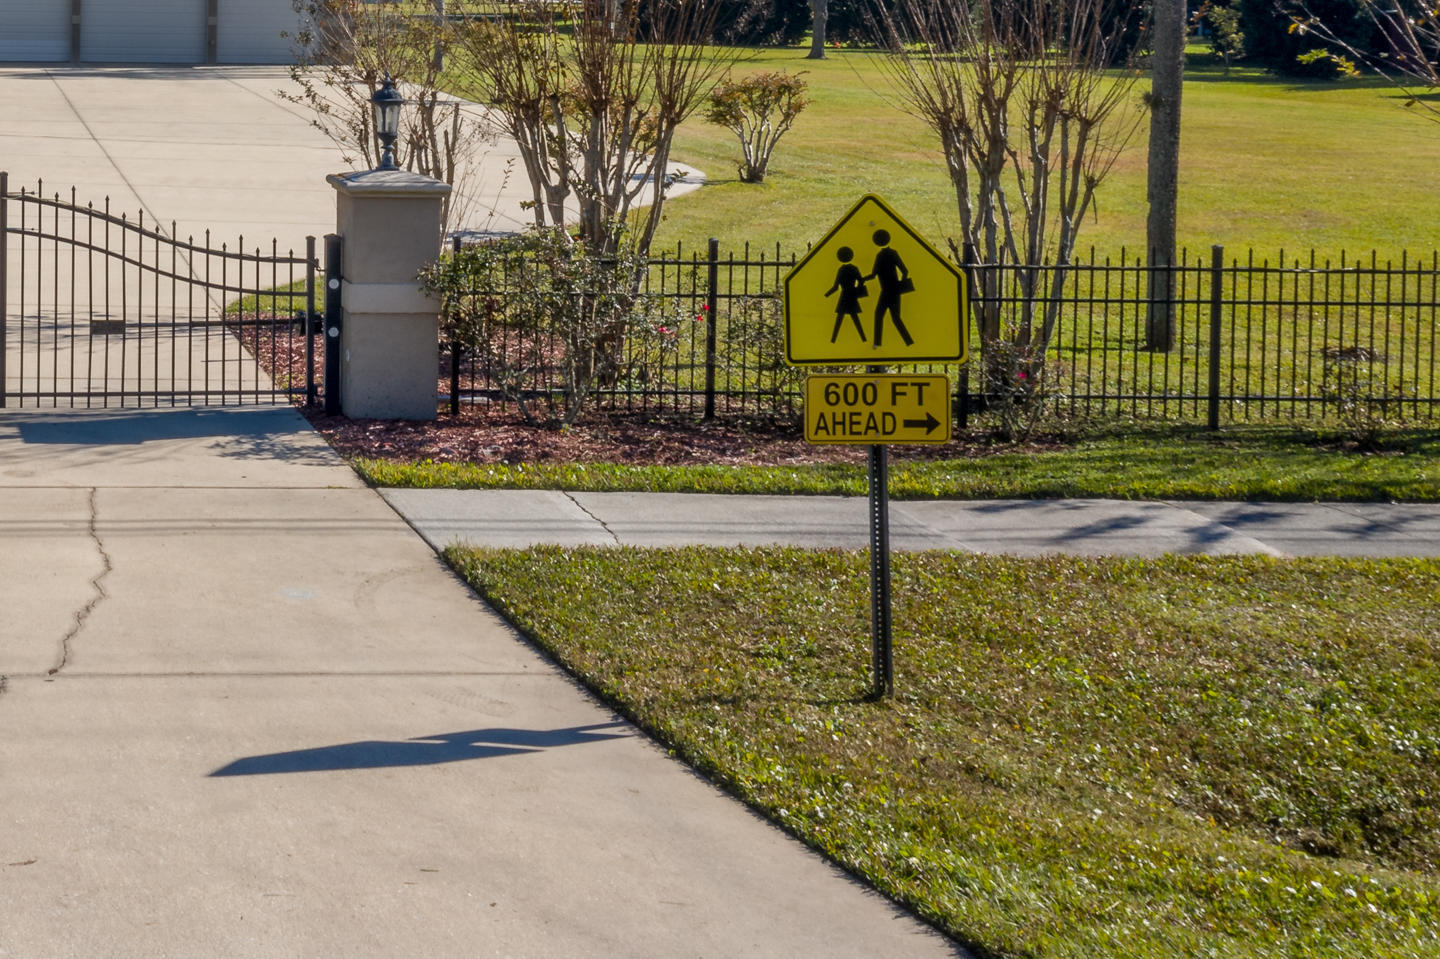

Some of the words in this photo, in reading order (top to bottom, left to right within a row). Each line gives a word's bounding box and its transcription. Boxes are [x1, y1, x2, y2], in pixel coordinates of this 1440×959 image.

[824, 382, 878, 406] 600
[891, 382, 930, 406] FT
[814, 411, 897, 436] AHEAD
